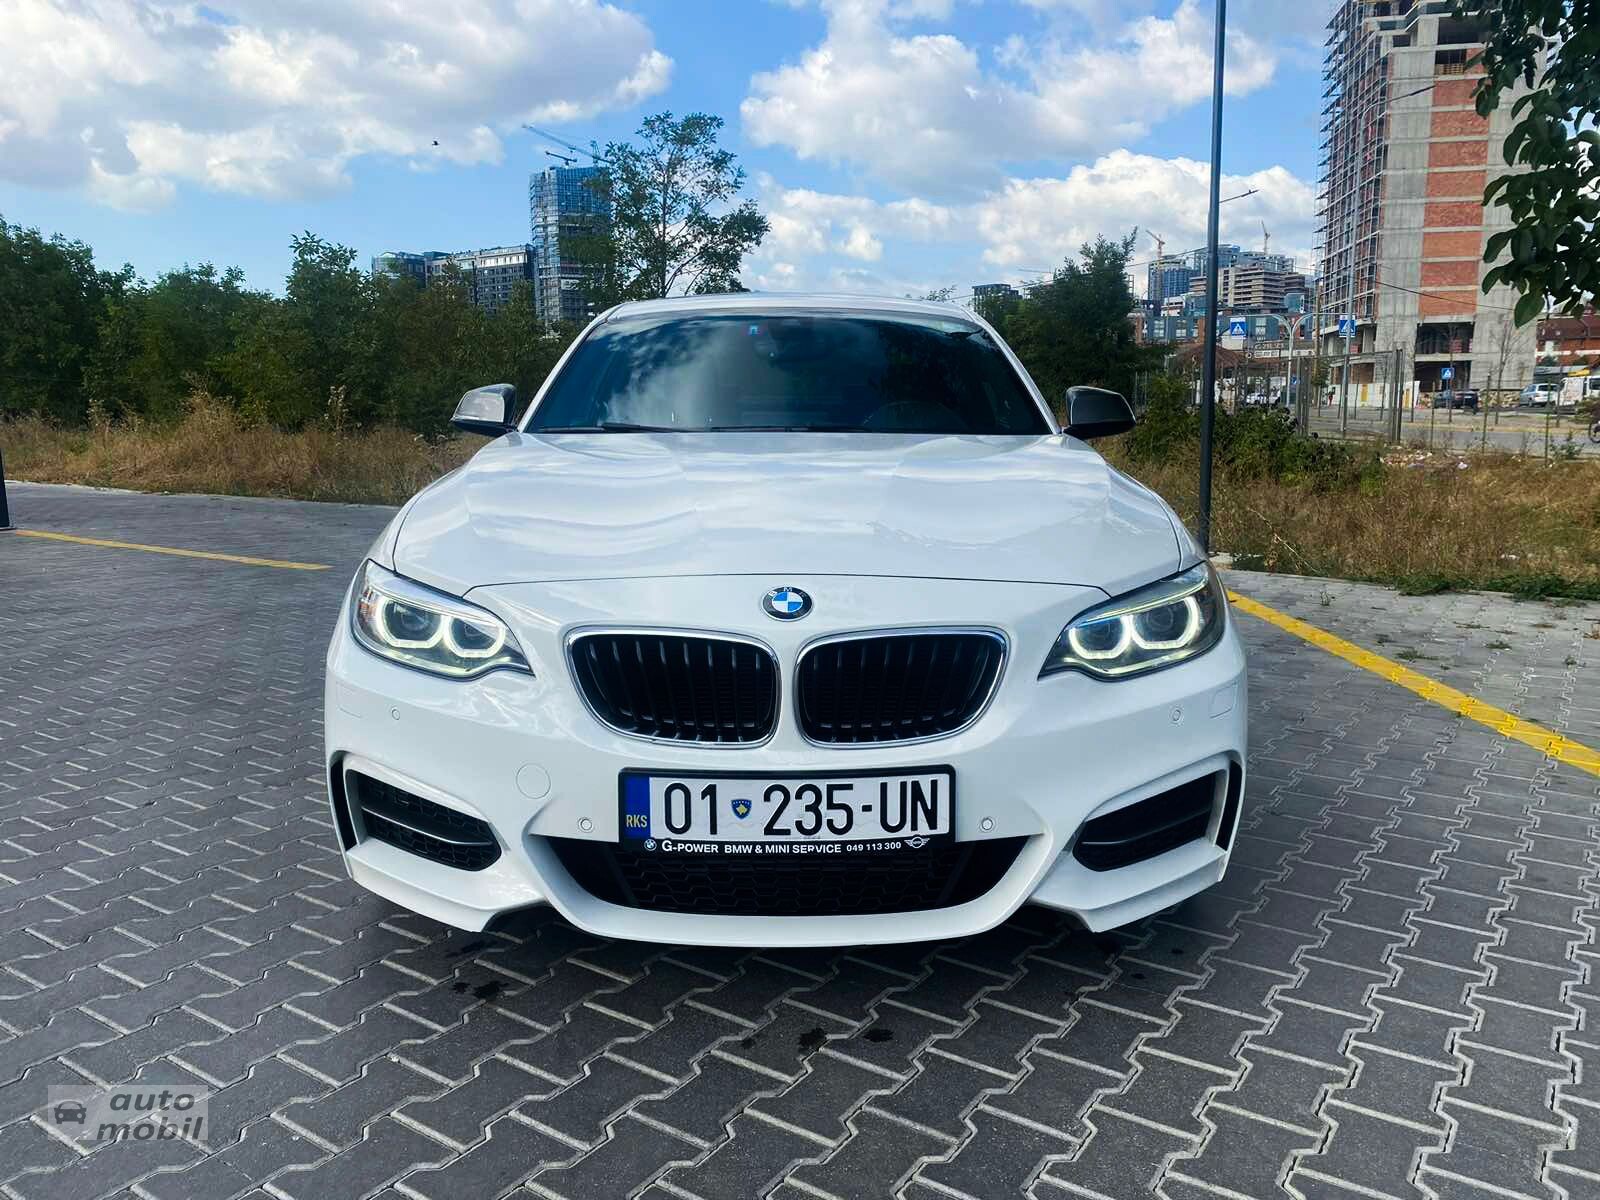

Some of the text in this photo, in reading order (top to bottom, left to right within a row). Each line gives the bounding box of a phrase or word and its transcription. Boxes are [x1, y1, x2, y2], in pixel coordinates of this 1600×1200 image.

[664, 779, 938, 836] 01 235-UN
[625, 813, 648, 828] RKS
[661, 839, 719, 854] G-POWER
[724, 844, 753, 854] BMW
[755, 844, 763, 853] &
[765, 844, 790, 854] MINI
[792, 844, 842, 854] SERVICE
[846, 843, 864, 852] 049
[866, 842, 883, 851] 113
[884, 841, 902, 850] 300
